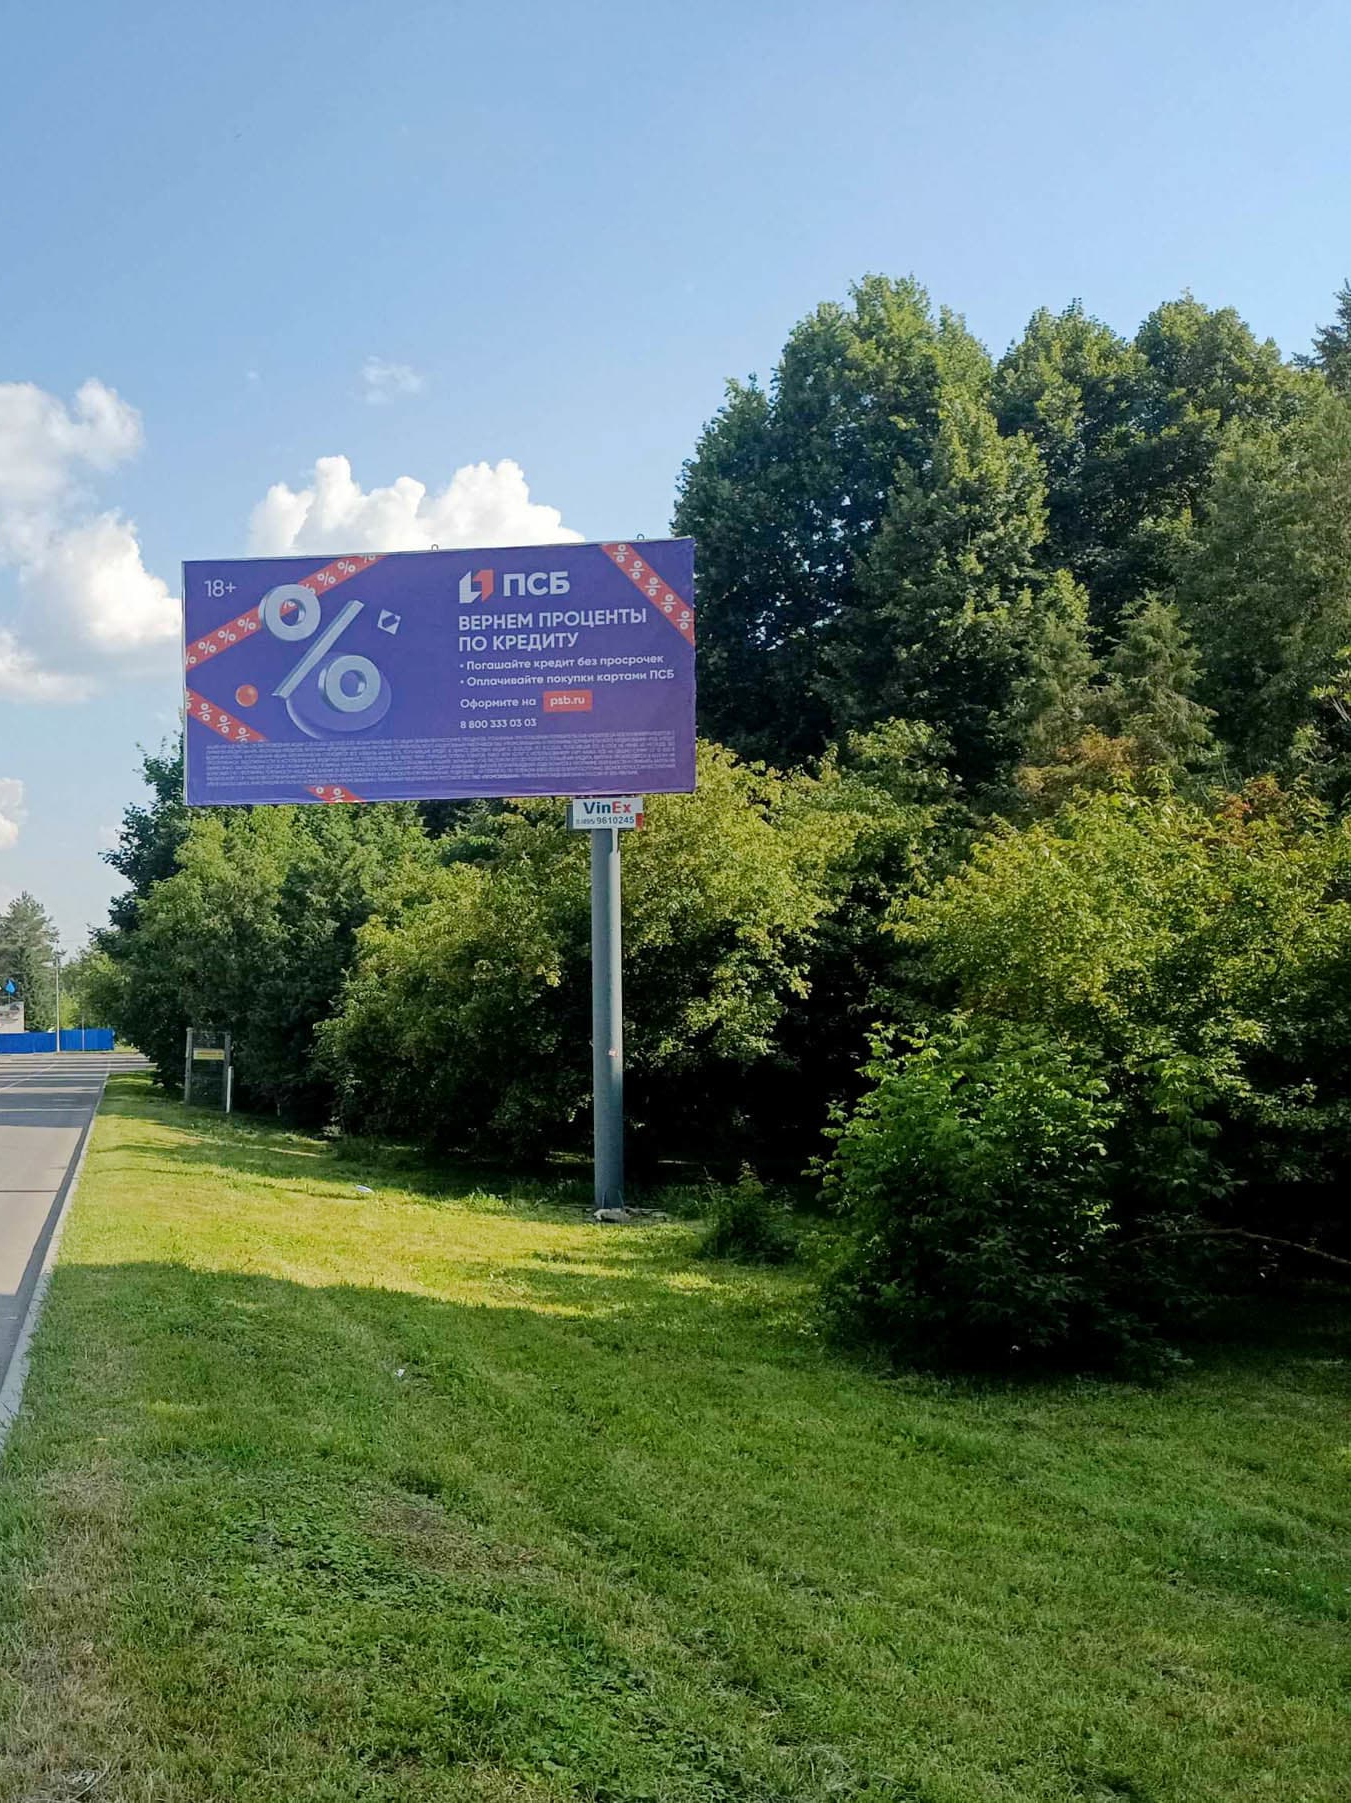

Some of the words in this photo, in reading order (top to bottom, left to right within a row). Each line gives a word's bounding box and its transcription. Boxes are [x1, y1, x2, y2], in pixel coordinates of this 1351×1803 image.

[204, 579, 237, 598] 18+
[503, 571, 570, 597] ПСБ
[458, 612, 533, 631] ВЕРНЕМ
[538, 608, 647, 628] ПРОЦЕНТЫ
[458, 636, 488, 652] ПО
[493, 632, 579, 651] КРЕДИТУ
[466, 660, 531, 671] Погашайте
[533, 659, 575, 669] кредит
[577, 656, 597, 667] без
[600, 654, 664, 668] просрочек
[466, 676, 544, 687] Оплачивайте
[546, 675, 594, 685] покупки
[596, 672, 647, 684] картами
[649, 669, 675, 680] ПСБ
[460, 698, 519, 709] Оформите
[550, 695, 586, 707] psb.ru
[460, 720, 466, 729] 8
[468, 719, 488, 729] 800
[490, 719, 508, 728] 333
[509, 719, 523, 728] 03
[524, 718, 537, 727] 03
[583, 801, 632, 814] VinEx
